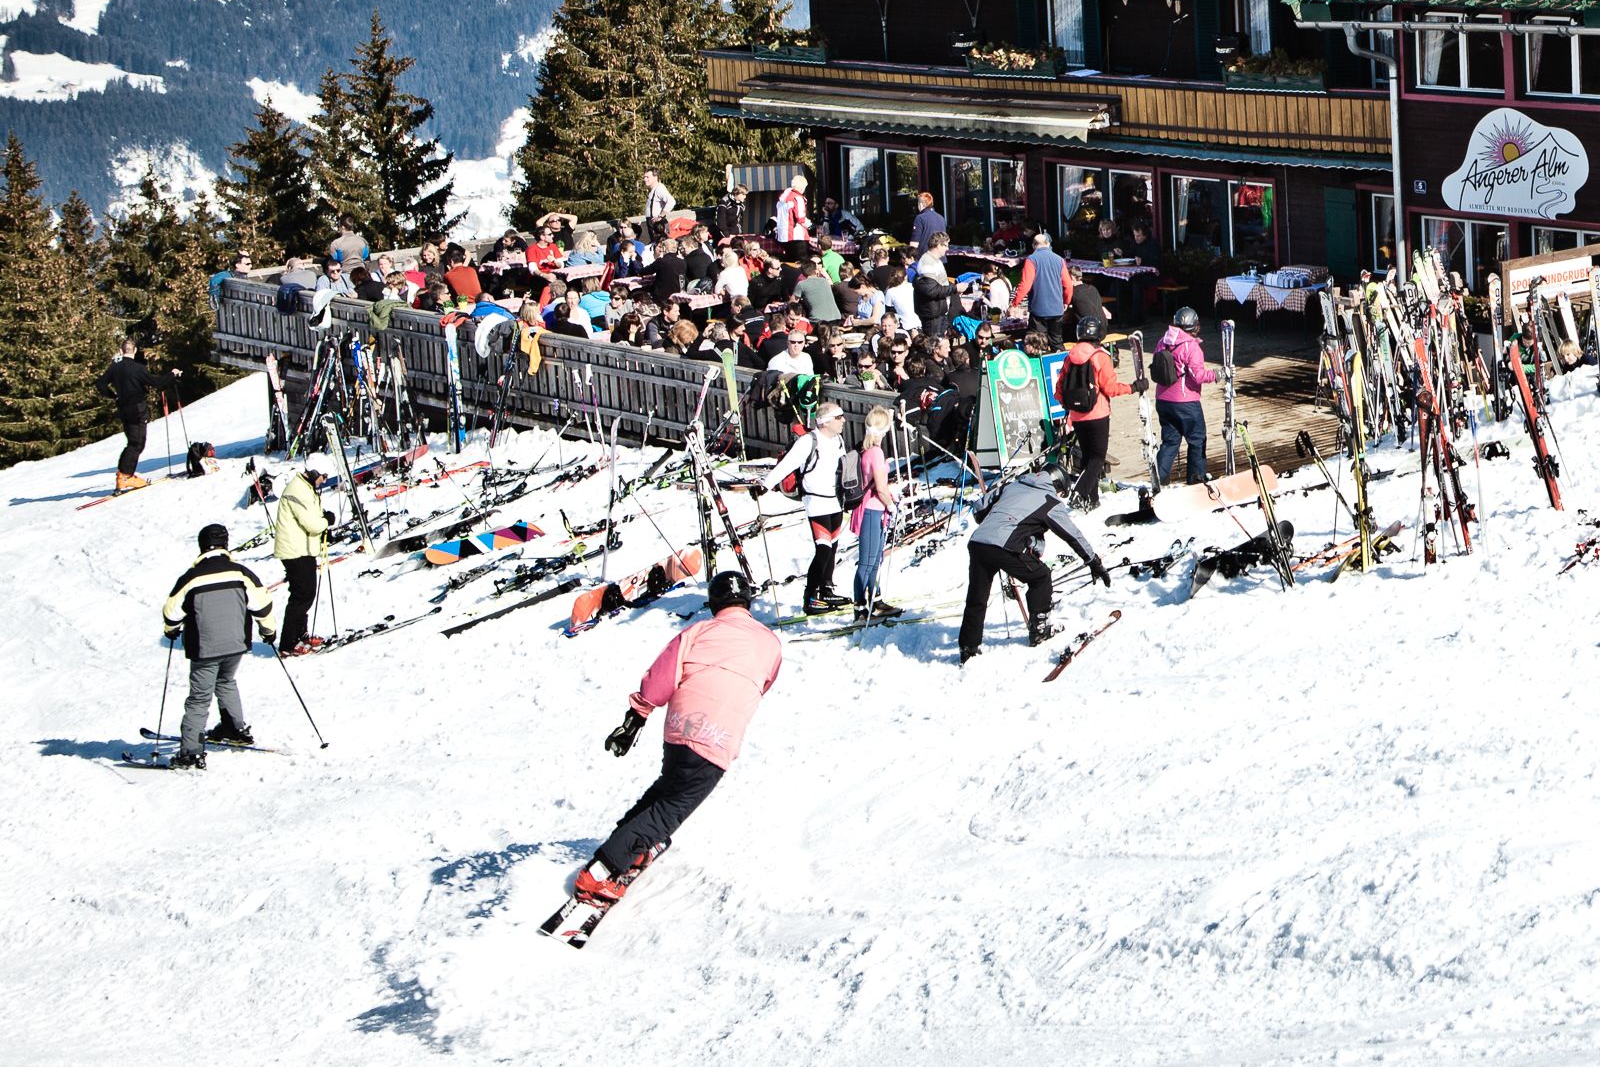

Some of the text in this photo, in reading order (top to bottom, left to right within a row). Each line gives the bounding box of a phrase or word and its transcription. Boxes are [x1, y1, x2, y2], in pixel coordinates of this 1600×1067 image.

[1418, 181, 1423, 190] 5
[1459, 146, 1570, 211] Angerer Alm
[1496, 205, 1506, 213] MIT
[1507, 206, 1538, 215] BEDIENUNG
[1512, 278, 1531, 292] SPO
[1542, 268, 1590, 285] UNDGRUBE
[1494, 287, 1503, 326] HEAD
